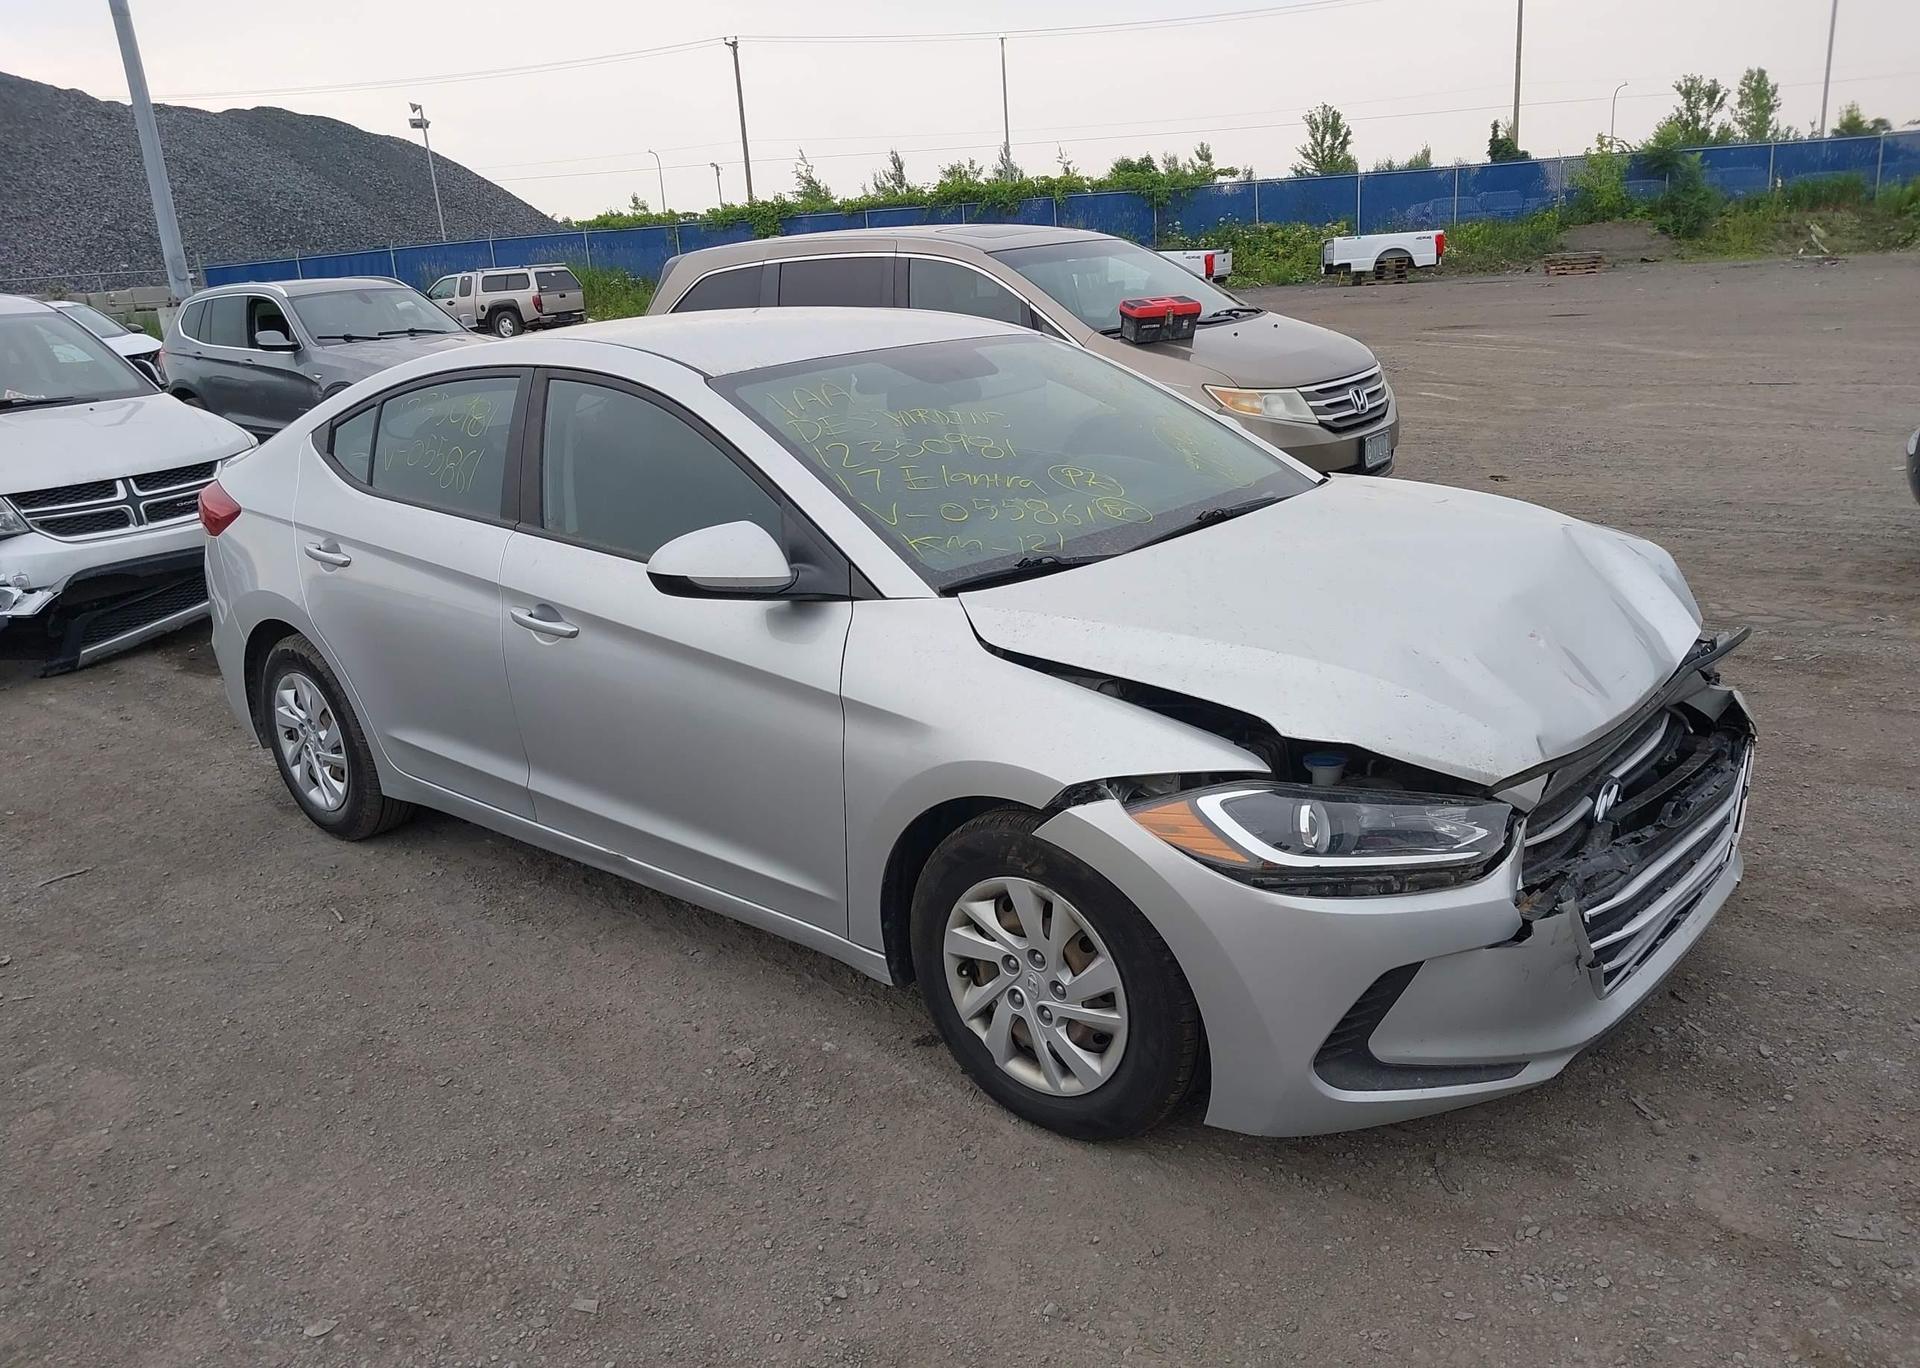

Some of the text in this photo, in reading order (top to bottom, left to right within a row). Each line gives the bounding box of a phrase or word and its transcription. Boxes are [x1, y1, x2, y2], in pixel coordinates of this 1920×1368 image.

[811, 432, 1017, 469] 12350981
[835, 467, 882, 498] 17
[899, 464, 1047, 495] Elantra
